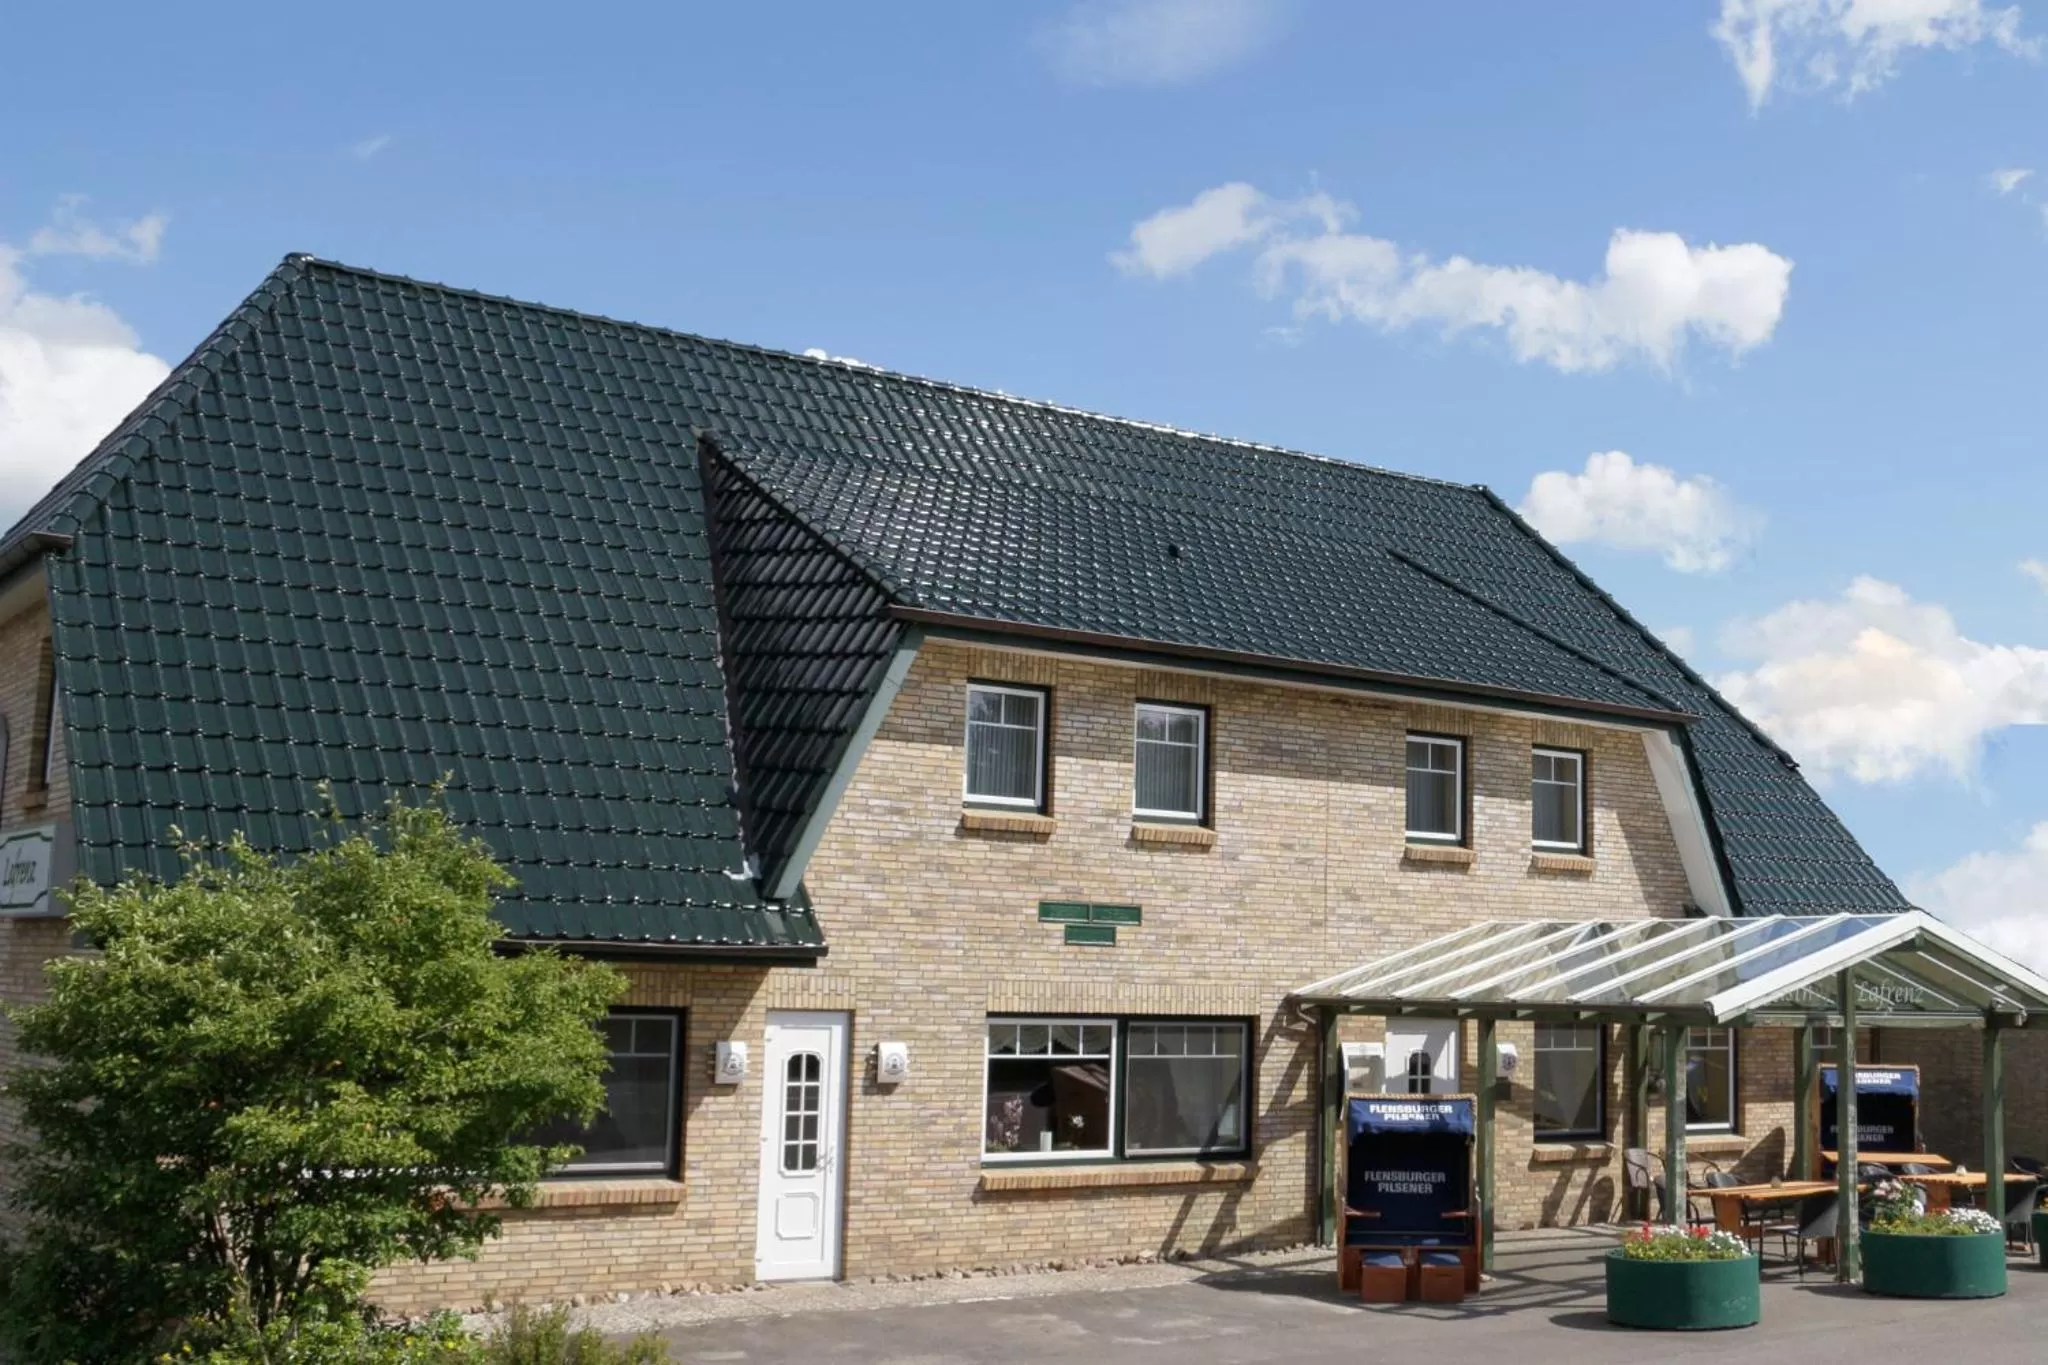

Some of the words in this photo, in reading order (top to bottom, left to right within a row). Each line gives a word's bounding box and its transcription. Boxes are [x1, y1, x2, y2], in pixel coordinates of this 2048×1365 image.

[1369, 1104, 1453, 1114] FLENSBURGER
[1384, 1113, 1440, 1121] PILSENER
[1364, 1171, 1446, 1183] FLENSBURGER
[1378, 1182, 1433, 1194] PILSENER
